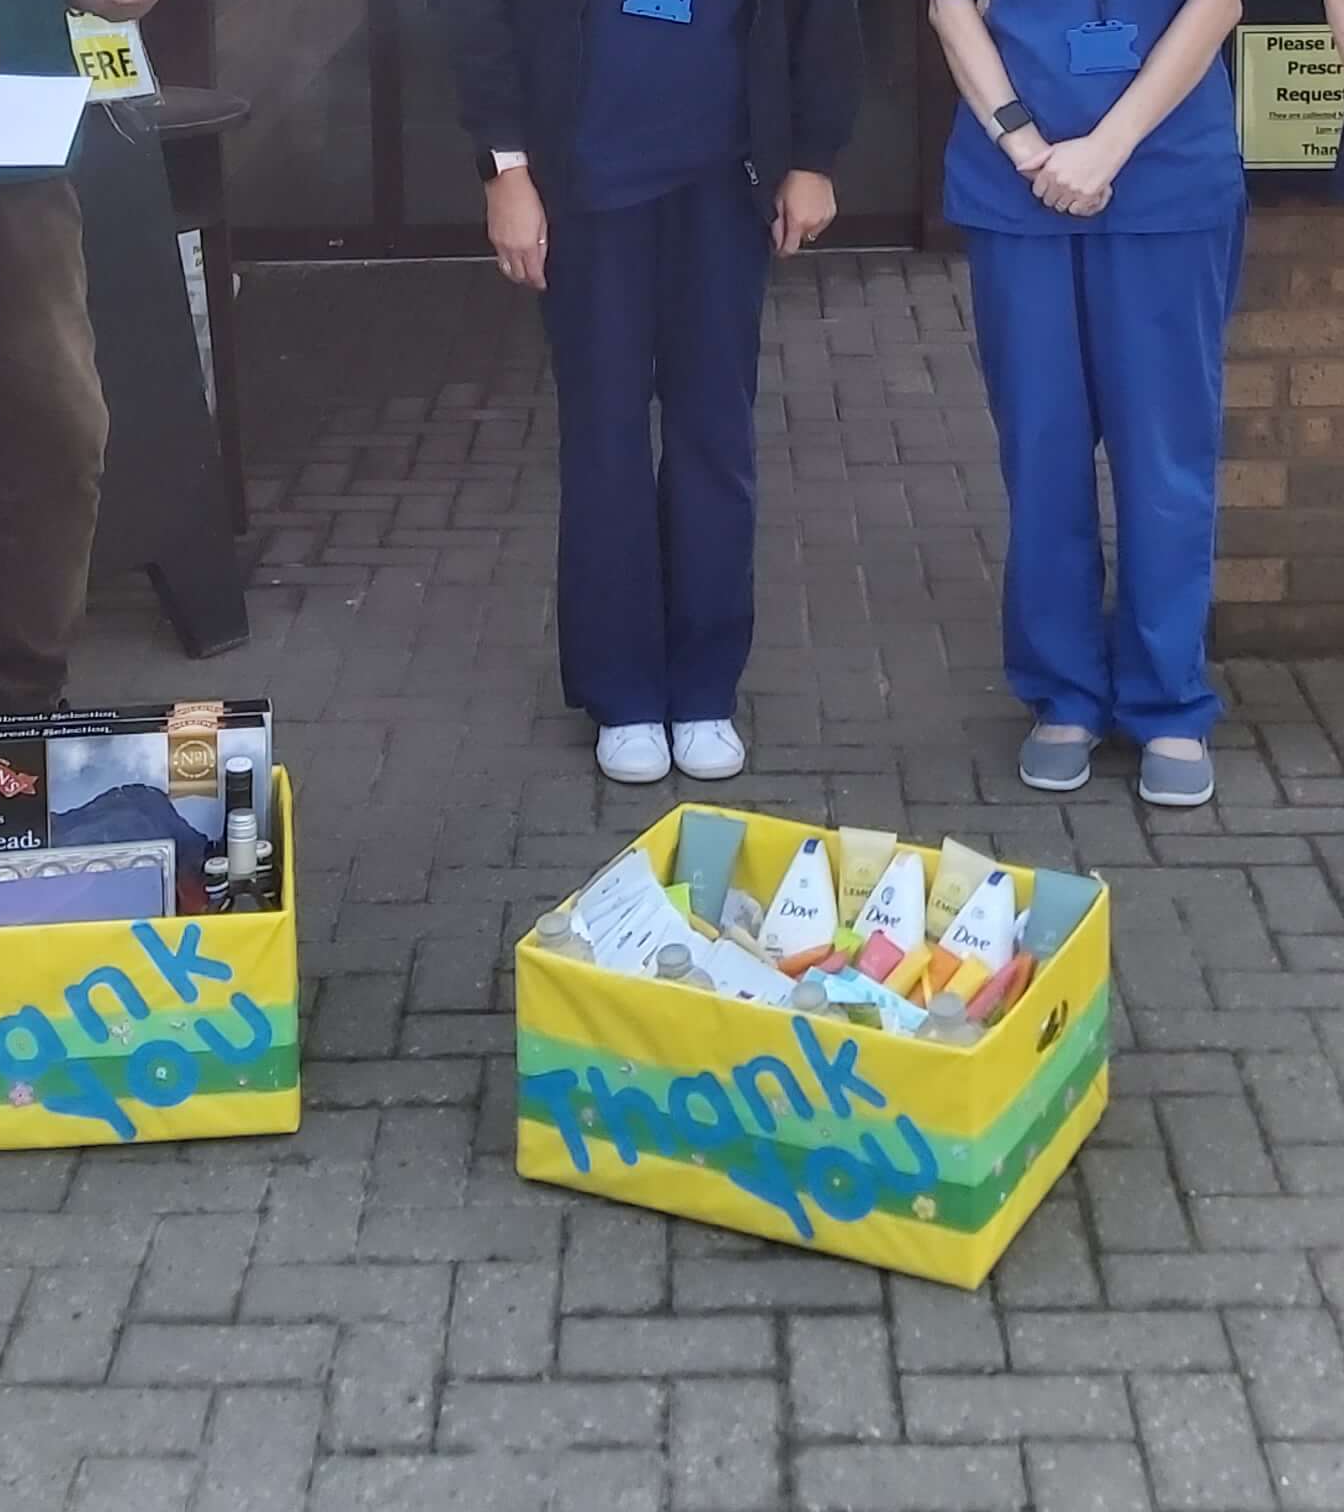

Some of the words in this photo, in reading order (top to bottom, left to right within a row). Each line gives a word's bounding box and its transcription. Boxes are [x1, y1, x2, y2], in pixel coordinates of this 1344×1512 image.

[1266, 36, 1325, 51] Please
[79, 47, 138, 80] ERE
[1287, 61, 1344, 75] Prescr
[1302, 143, 1338, 156] Than
[50, 711, 119, 721] Selection
[42, 725, 112, 737] Selection
[780, 899, 818, 919] Dove
[865, 905, 902, 929] Dove
[952, 925, 991, 952] Dove
[520, 1015, 886, 1173] Thank
